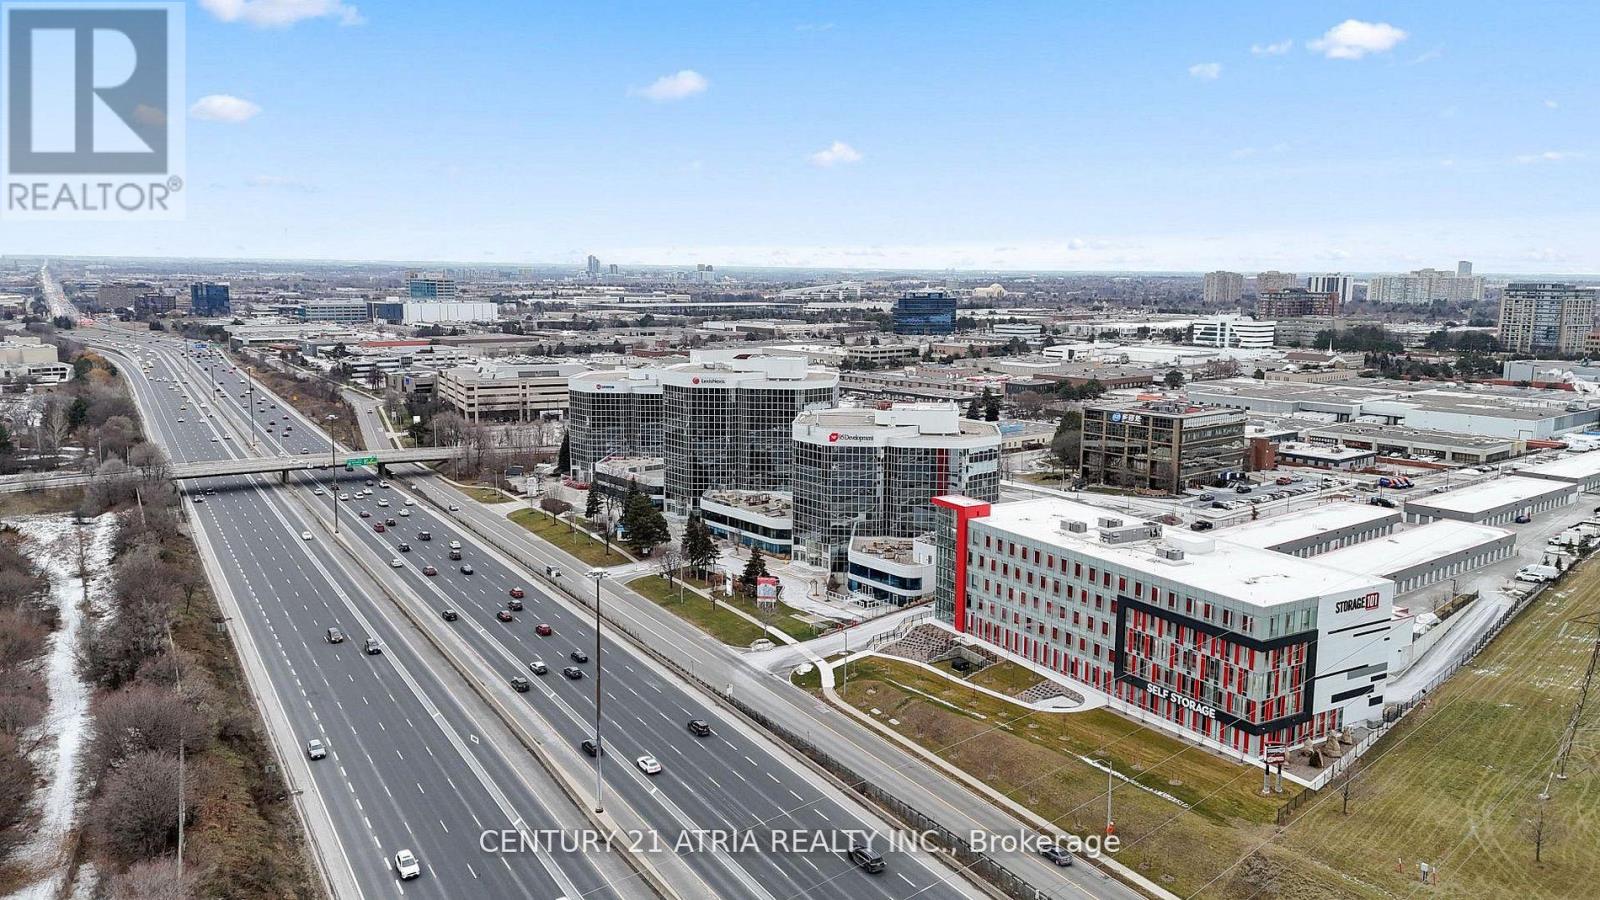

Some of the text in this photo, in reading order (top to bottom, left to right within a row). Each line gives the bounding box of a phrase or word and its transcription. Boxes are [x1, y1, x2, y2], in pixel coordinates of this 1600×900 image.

[1335, 594, 1379, 614] STORAGE 101
[1146, 683, 1216, 719] SELF STORAGE
